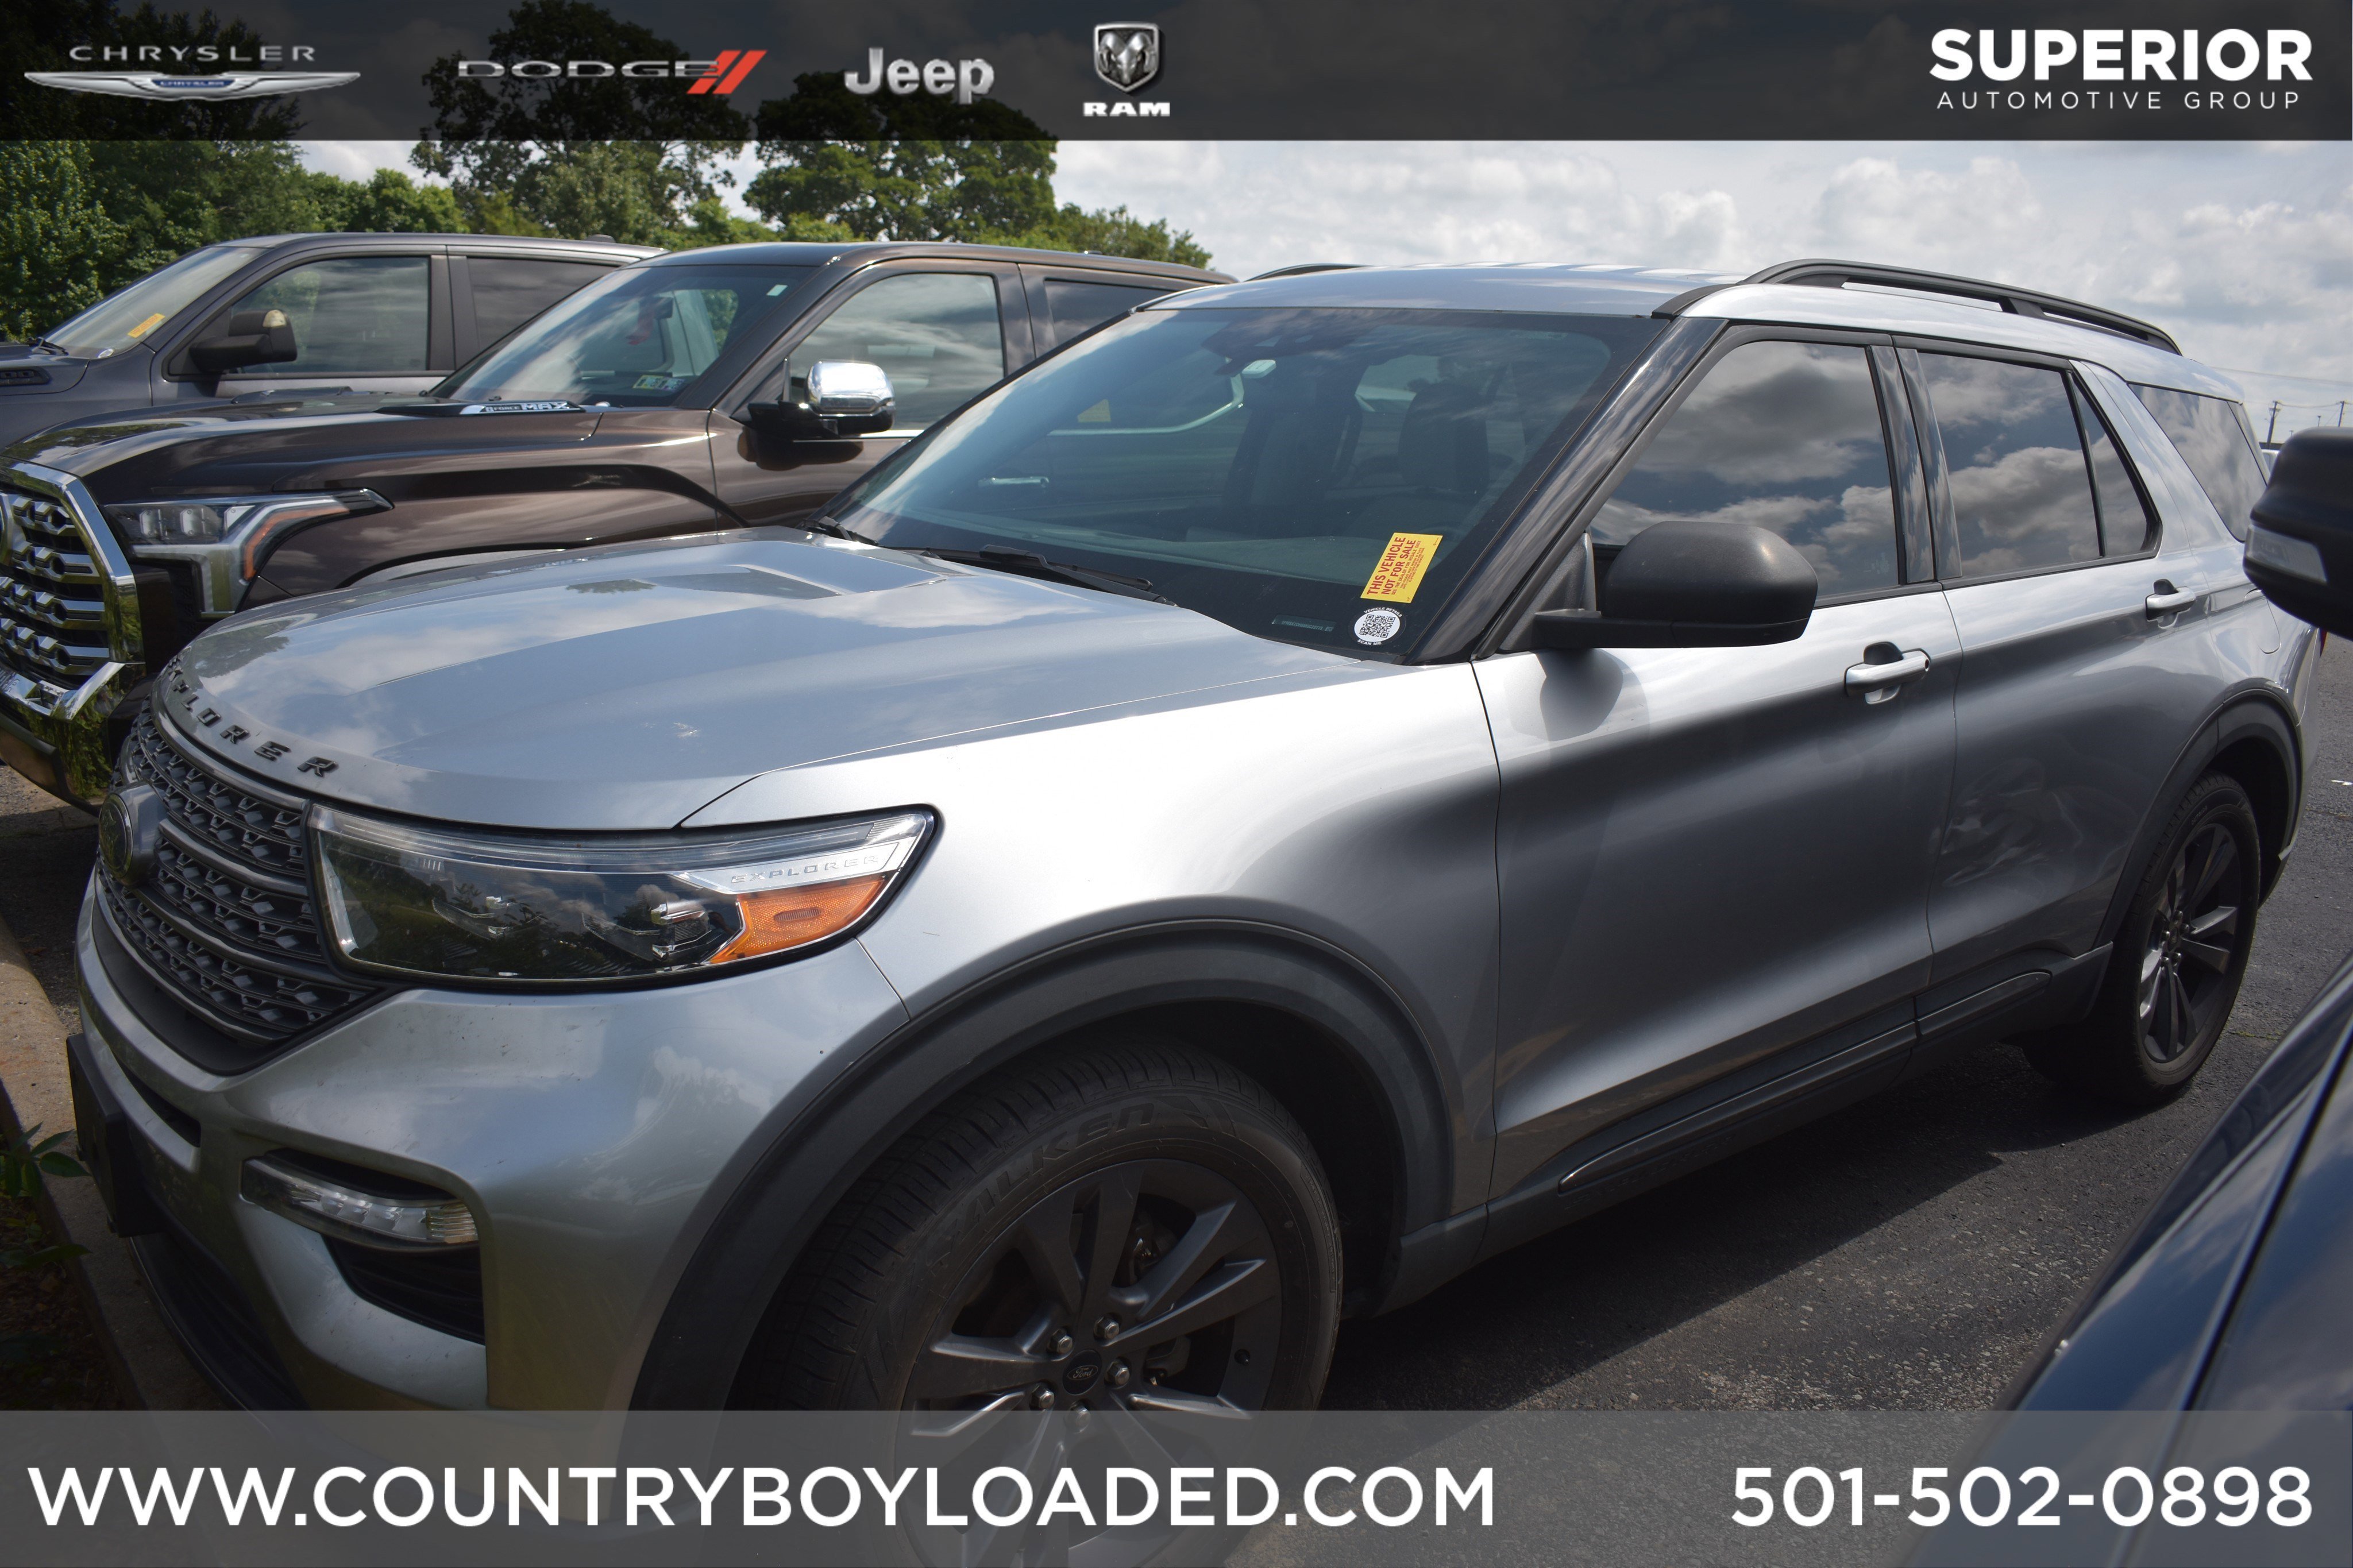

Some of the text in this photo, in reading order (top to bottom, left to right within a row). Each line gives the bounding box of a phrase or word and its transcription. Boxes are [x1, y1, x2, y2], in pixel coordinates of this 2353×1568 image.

[522, 401, 570, 411] MAX
[1367, 537, 1406, 595] THIS VEHICLE
[1381, 579, 1395, 594] NOT
[1390, 561, 1405, 577] FOR
[1400, 540, 1416, 559] SALE
[1386, 607, 1402, 617] DETAILS
[731, 855, 878, 884] EXPLORER
[1073, 1368, 1094, 1378] Ford
